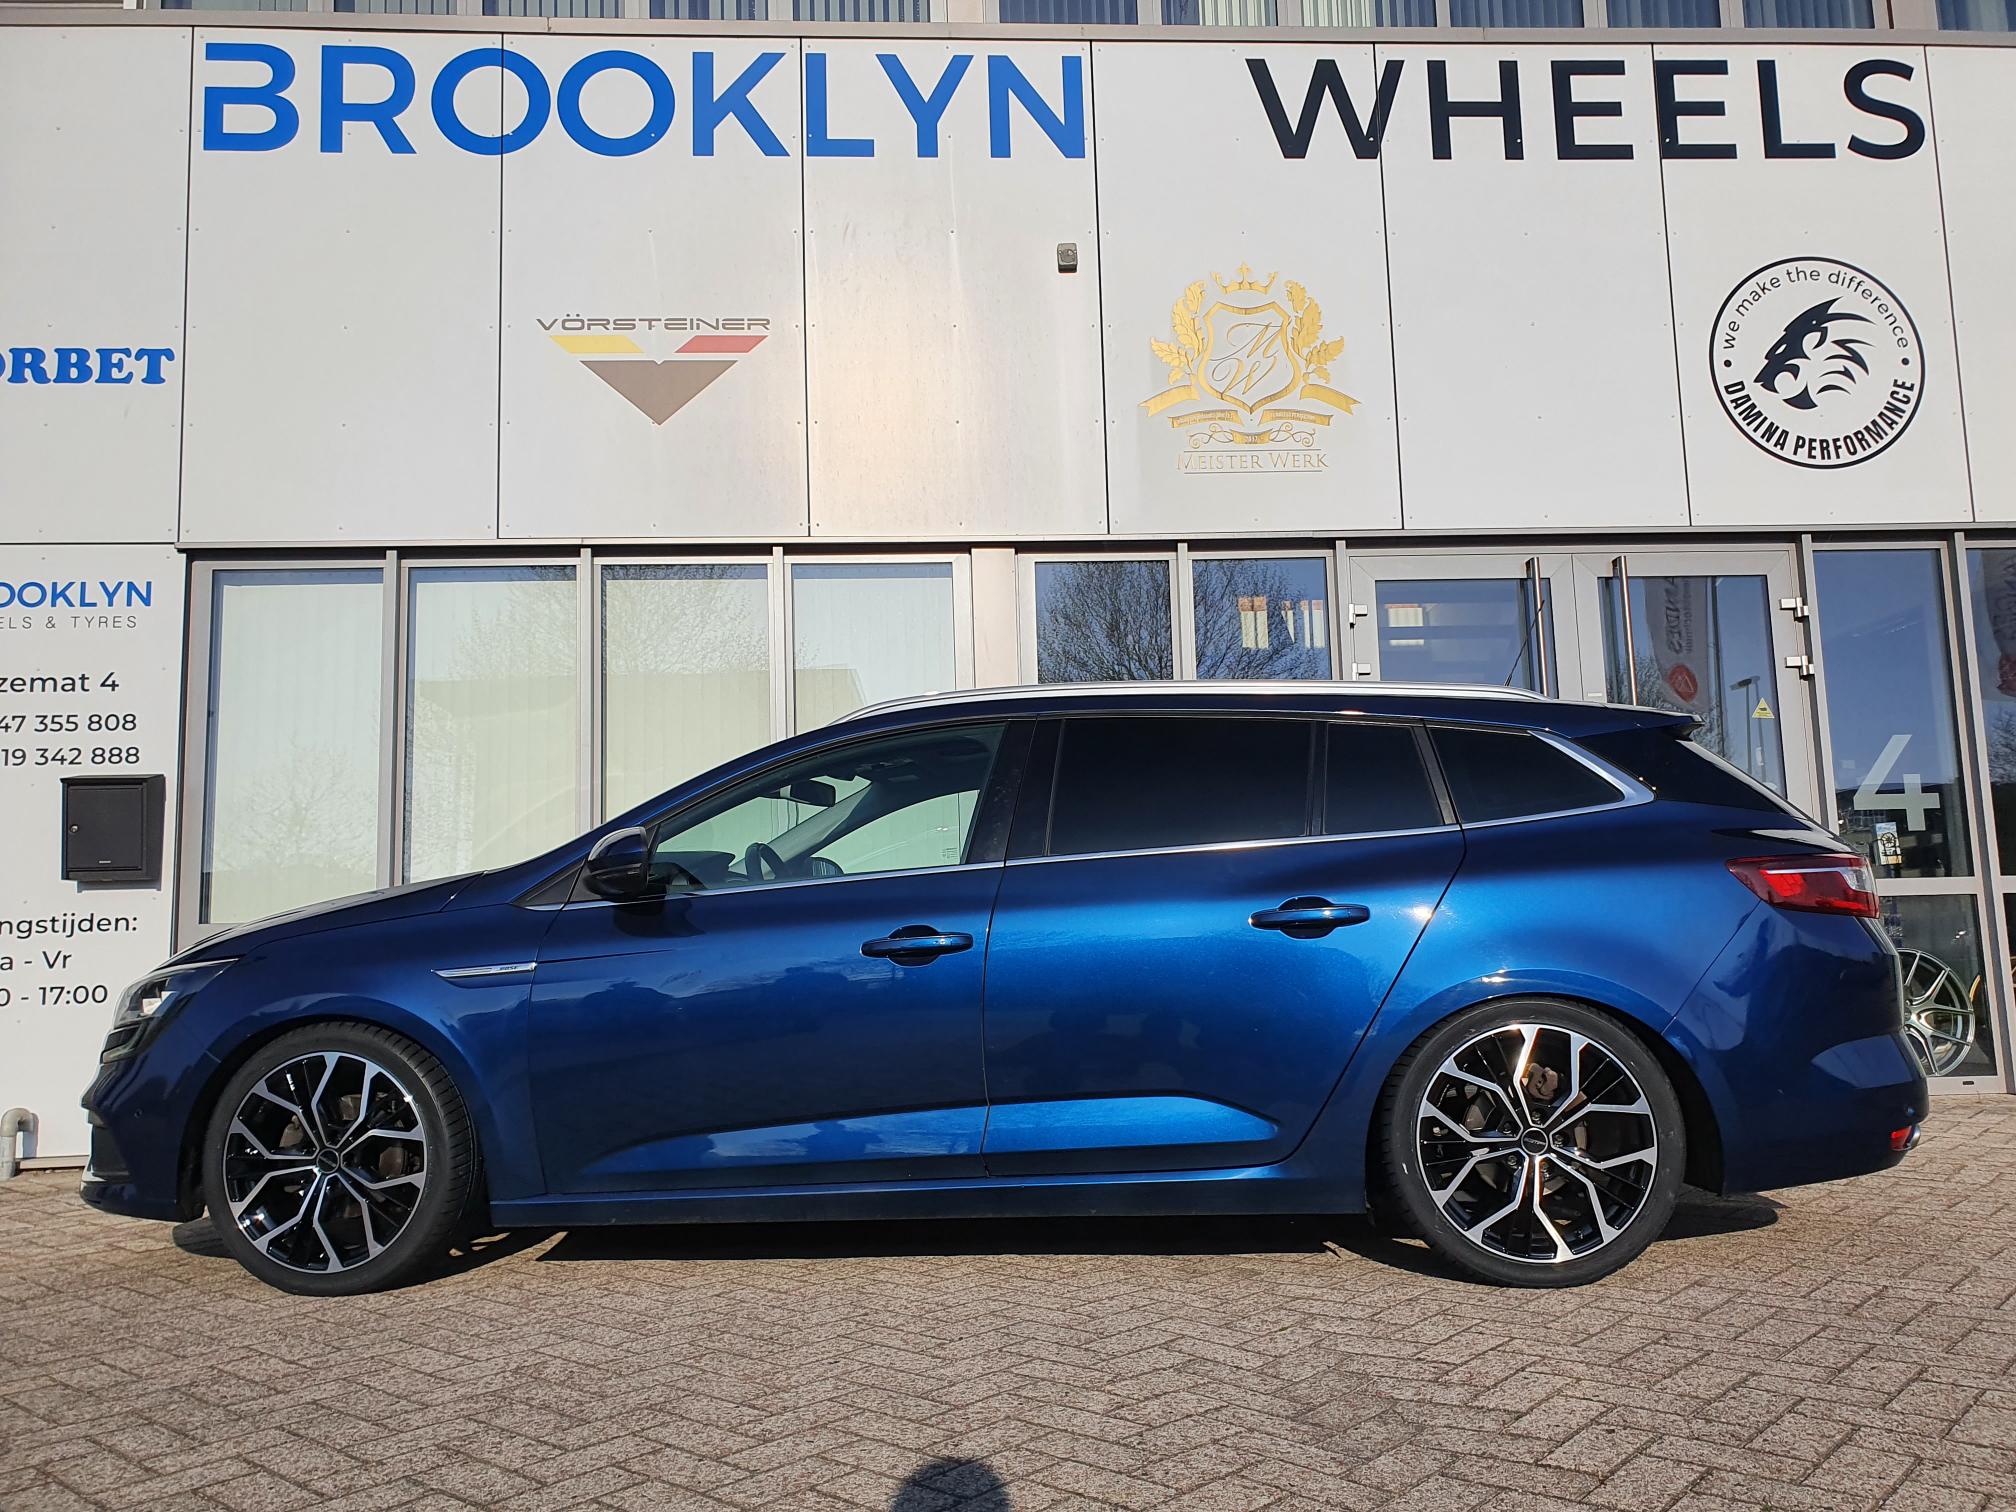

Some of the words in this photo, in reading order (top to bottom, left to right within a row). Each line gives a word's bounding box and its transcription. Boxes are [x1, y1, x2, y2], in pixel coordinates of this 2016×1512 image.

[203, 42, 1085, 158] BROOKLYN
[1245, 59, 1926, 160] WHEELS
[1723, 320, 1740, 350] we
[1735, 276, 1781, 317] make
[1786, 266, 1820, 283] the
[1828, 270, 1909, 349] difference
[536, 313, 771, 331] VÖRSTEINER
[0, 348, 175, 384] RBET
[1723, 380, 1790, 451] DAMINA
[1793, 379, 1915, 460] PERFORMANCE
[1177, 453, 1263, 470] MEISTER
[1269, 452, 1328, 468] WERK
[45, 616, 57, 629] &
[71, 615, 137, 629] TYRES
[100, 672, 120, 692] 4
[0, 715, 26, 733] 47
[34, 715, 79, 732] 355
[87, 713, 137, 732] 808
[1, 749, 27, 767] 19
[35, 748, 82, 766] 342
[91, 746, 140, 765] 888
[1853, 734, 1940, 831] 4
[42, 950, 72, 970] Vr
[39, 984, 108, 1006] 17:00
